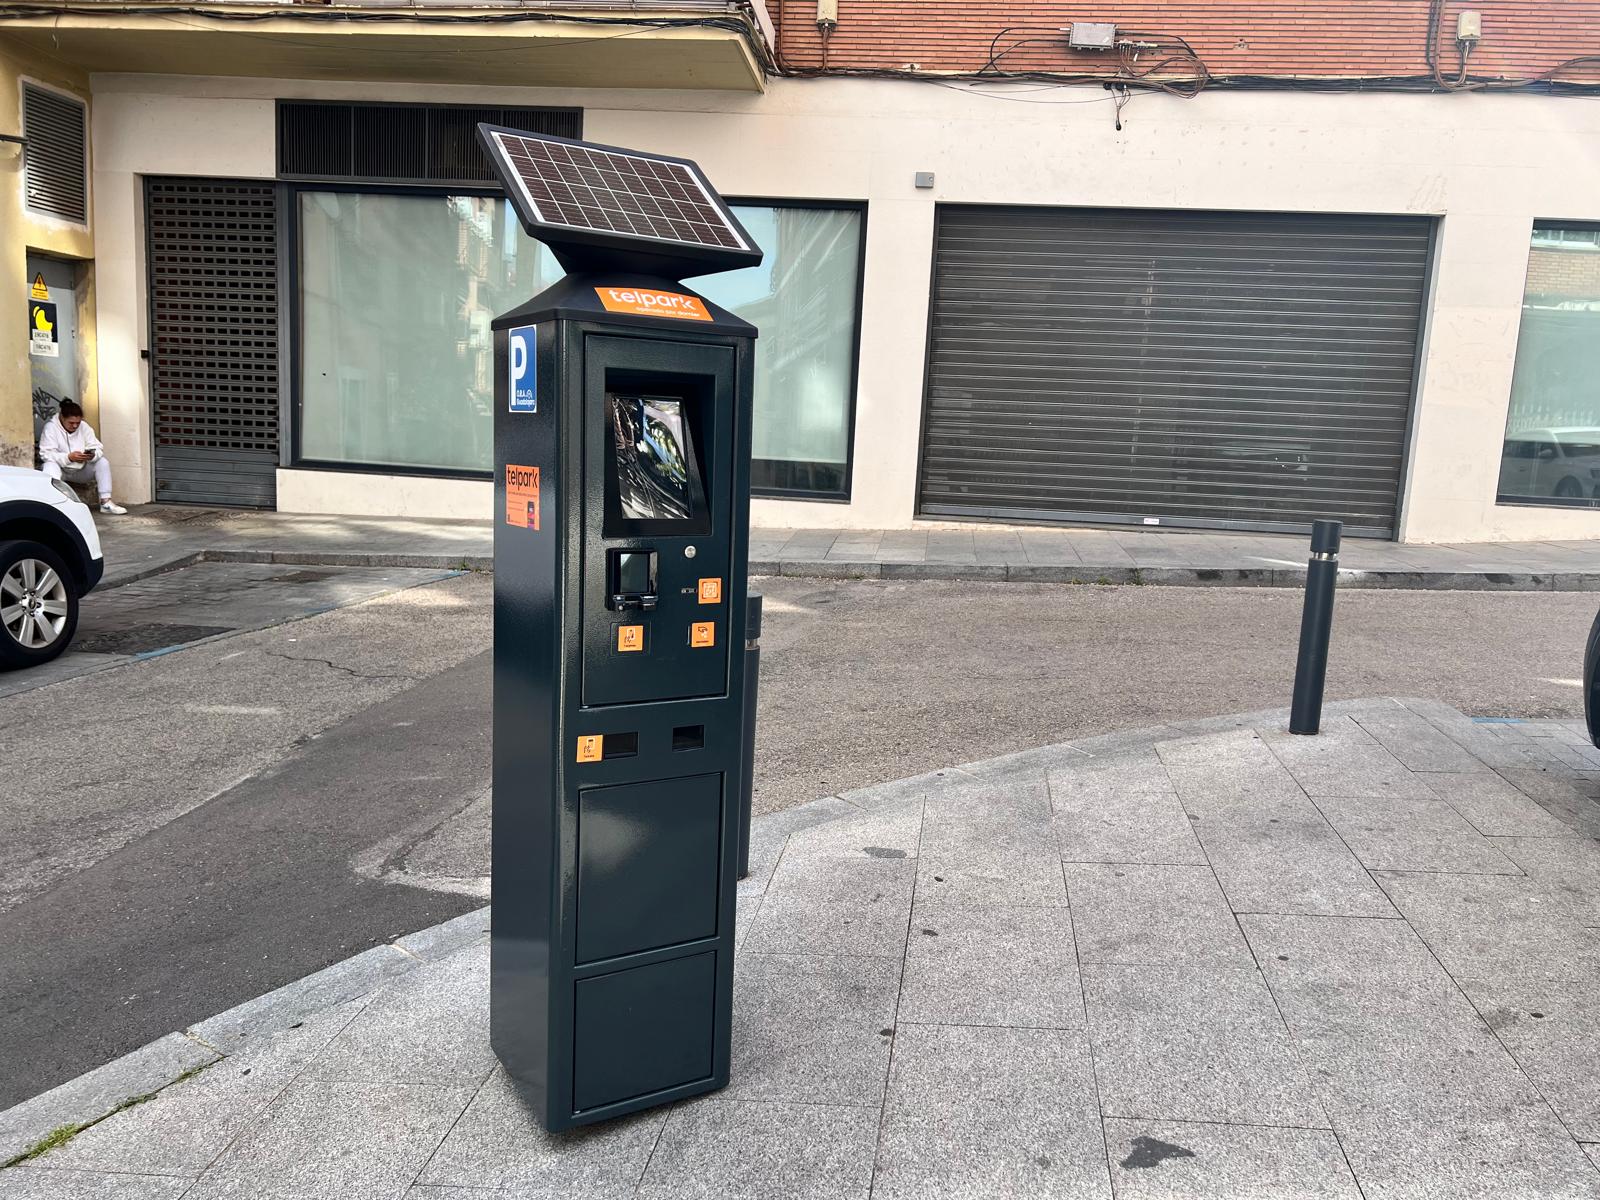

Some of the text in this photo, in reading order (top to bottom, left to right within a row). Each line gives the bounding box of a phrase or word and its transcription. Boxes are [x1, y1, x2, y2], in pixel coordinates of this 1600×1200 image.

[609, 289, 697, 310] telpark
[511, 335, 527, 405] P
[507, 466, 538, 491] telpark
